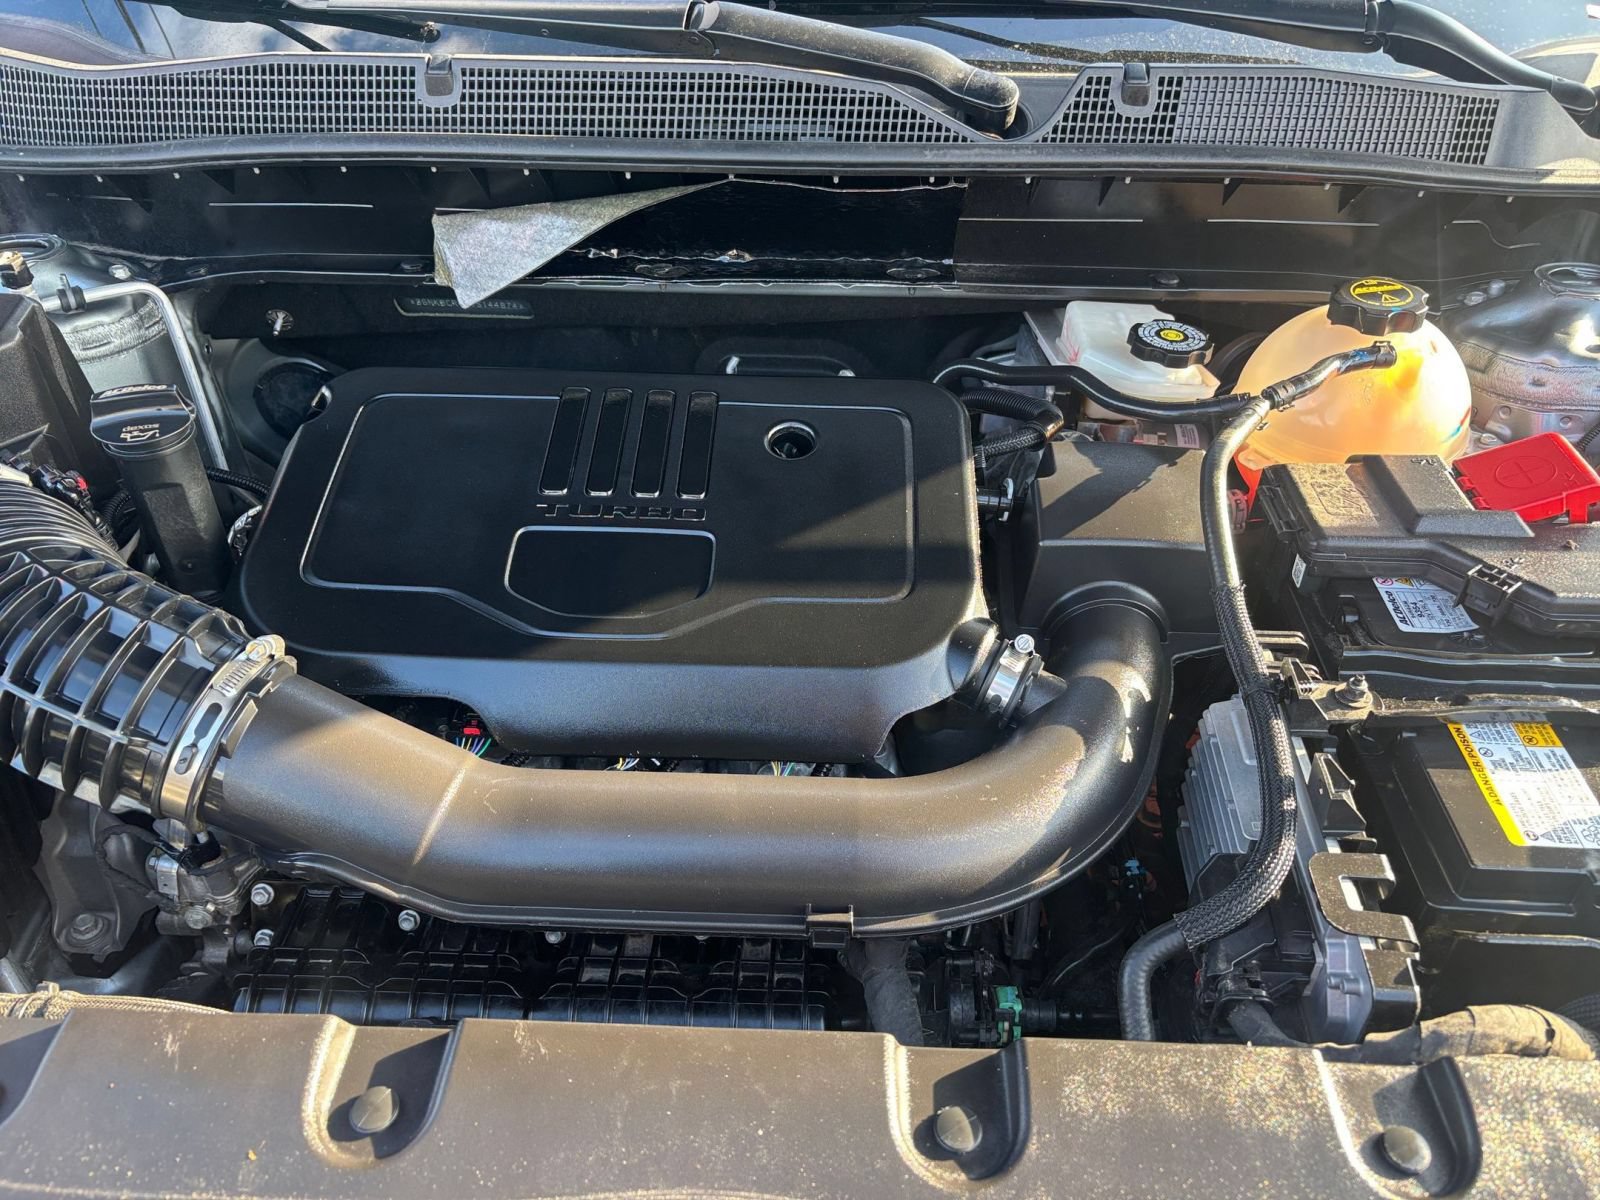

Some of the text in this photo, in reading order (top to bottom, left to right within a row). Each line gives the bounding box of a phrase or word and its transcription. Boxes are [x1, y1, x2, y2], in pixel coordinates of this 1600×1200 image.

[99, 384, 167, 398] ACDelco
[122, 423, 160, 432] dexos
[536, 504, 706, 521] TURBO
[1385, 590, 1410, 626] ACDelco
[1453, 726, 1498, 799] DANGER/POISON
